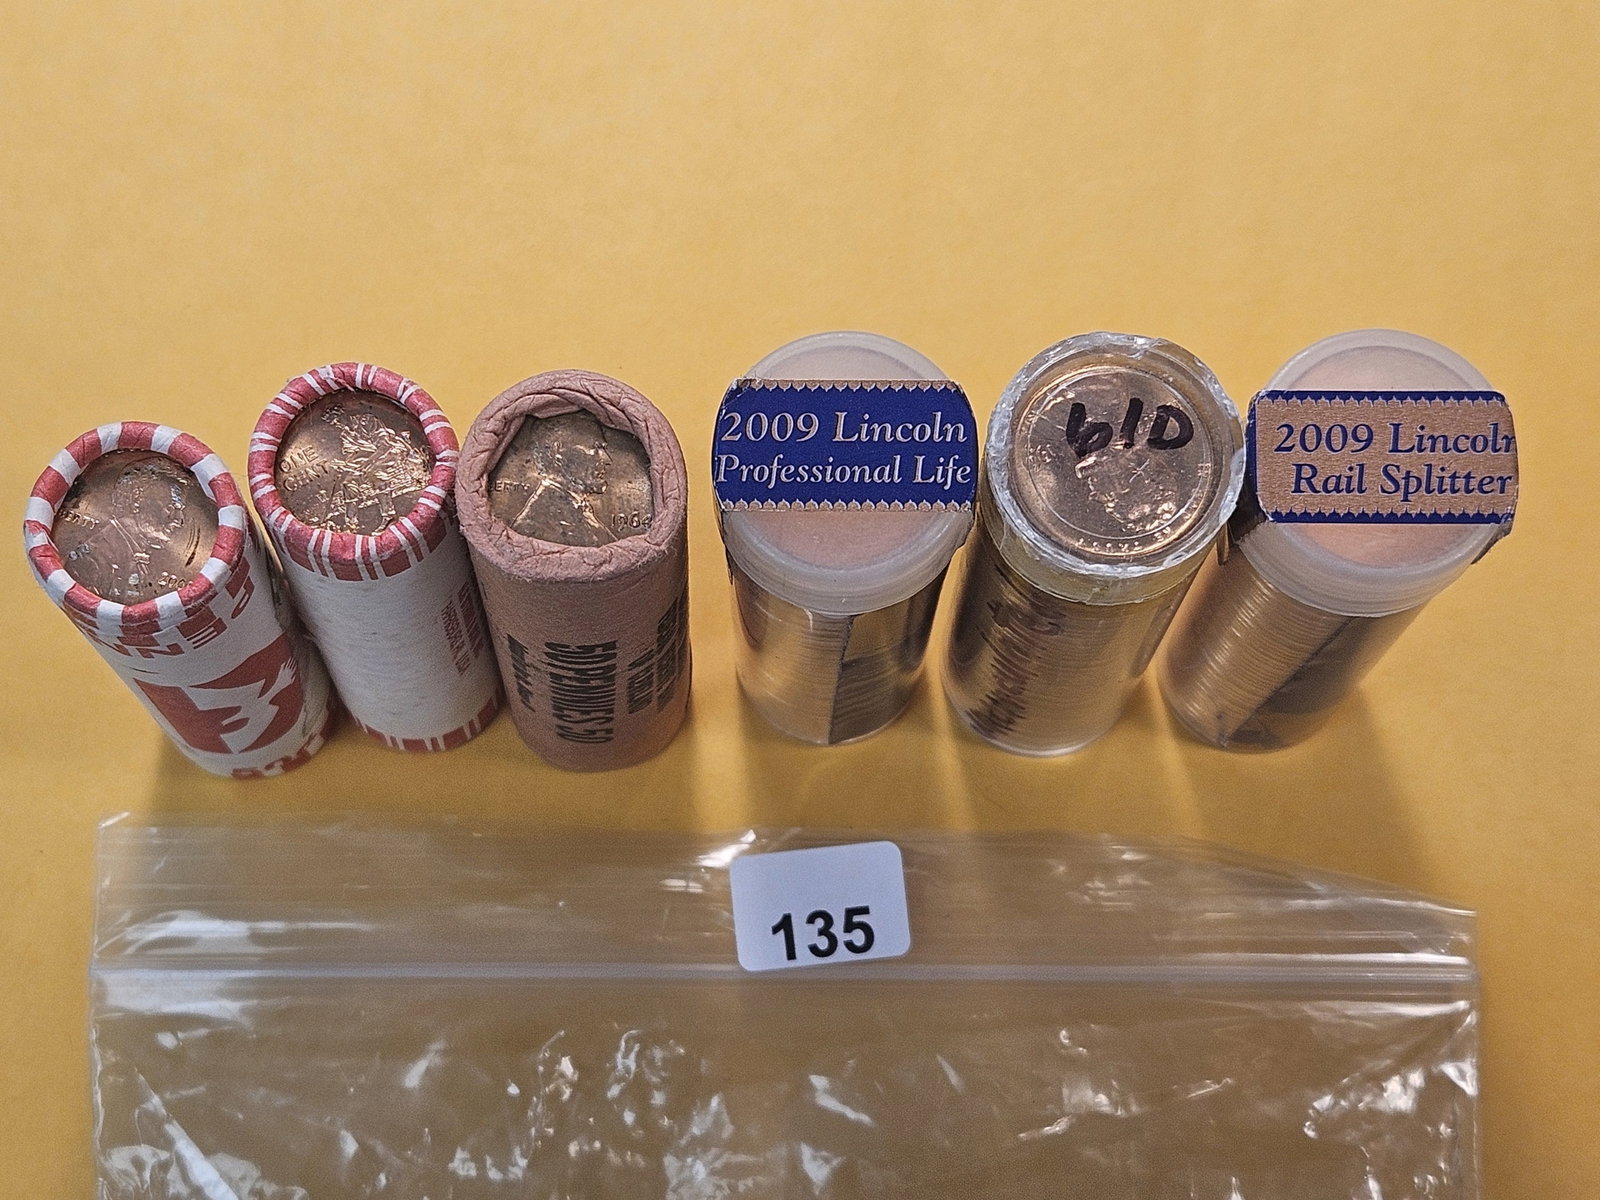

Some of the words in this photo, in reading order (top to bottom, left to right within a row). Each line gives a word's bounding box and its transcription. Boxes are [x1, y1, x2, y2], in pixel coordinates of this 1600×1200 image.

[720, 411, 820, 443] 2009
[832, 410, 968, 443] Lincoln
[1273, 422, 1375, 454] 2009
[280, 444, 318, 473] ONE
[284, 458, 328, 492] CENT
[716, 453, 902, 489] Professional
[912, 454, 972, 490] Life
[1290, 462, 1368, 495] Rail
[1379, 462, 1513, 503] Splitter
[771, 905, 875, 961] 135
